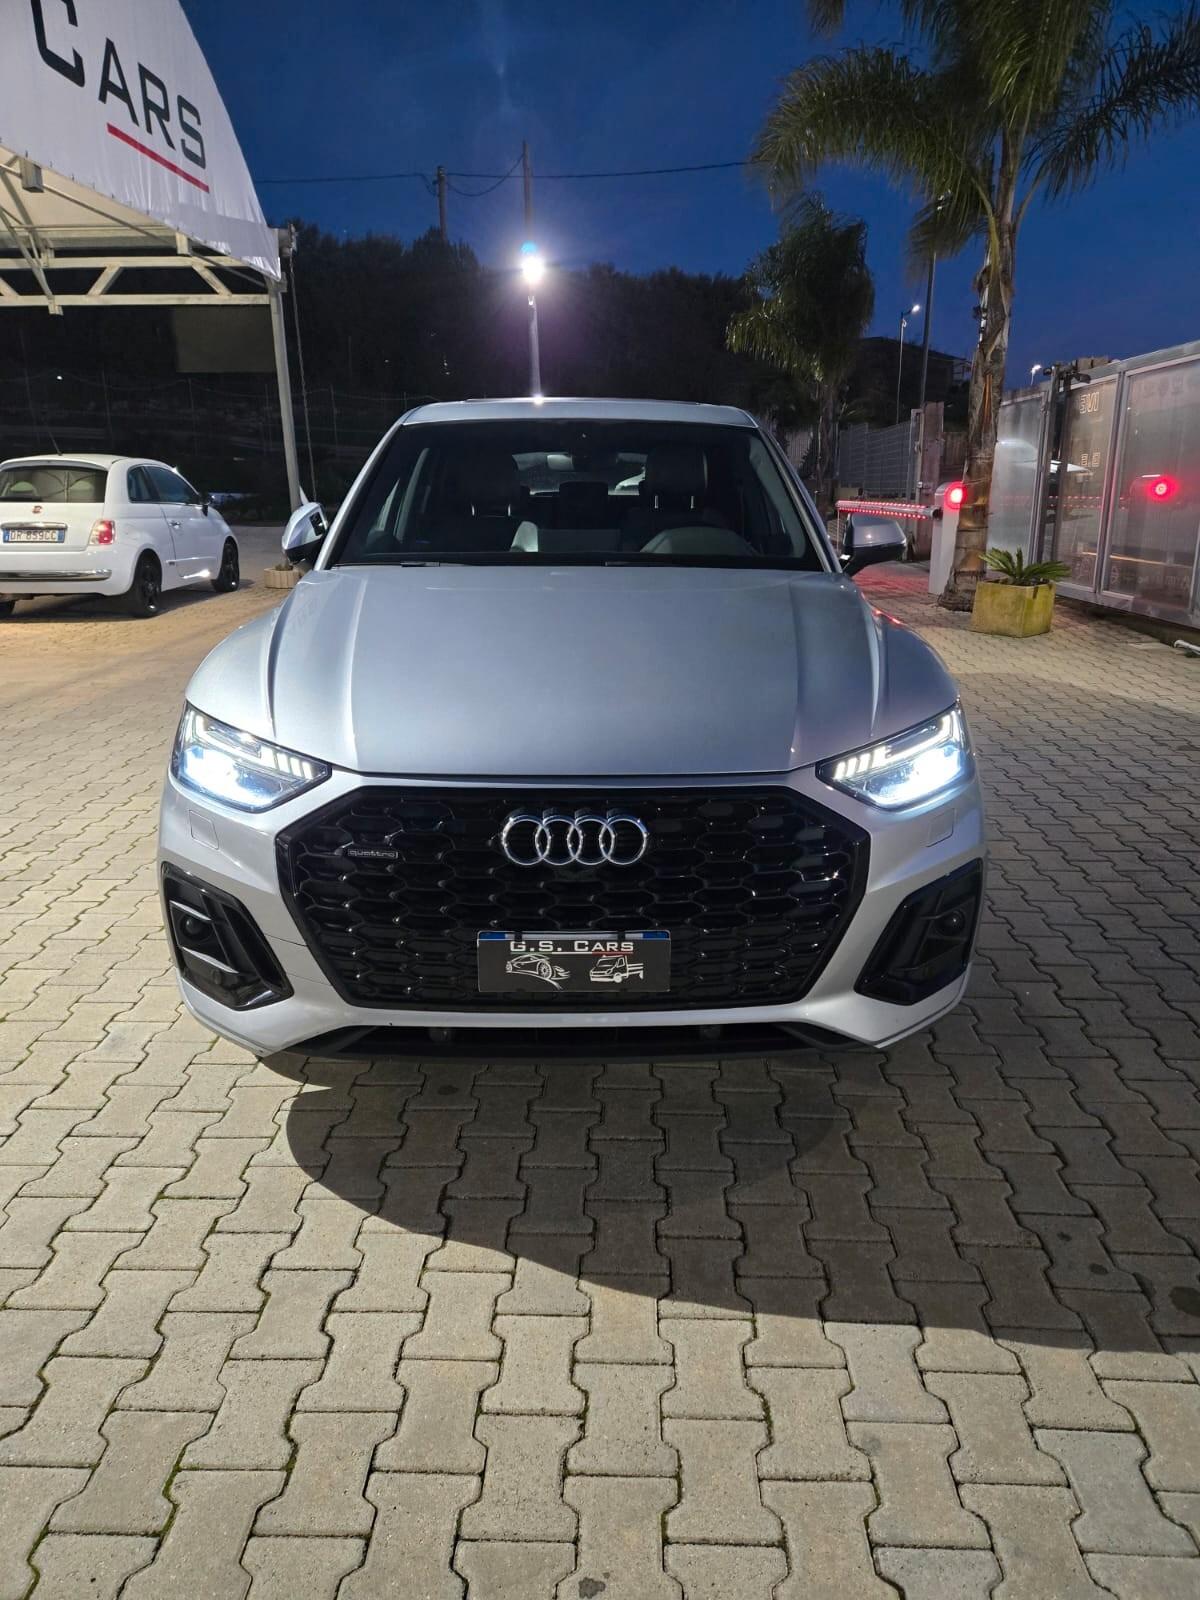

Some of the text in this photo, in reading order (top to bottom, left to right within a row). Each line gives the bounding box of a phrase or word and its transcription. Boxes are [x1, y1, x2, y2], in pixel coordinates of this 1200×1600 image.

[31, 0, 206, 170] CARS
[349, 850, 395, 858] quattro
[510, 940, 634, 952] G.S. CARS
